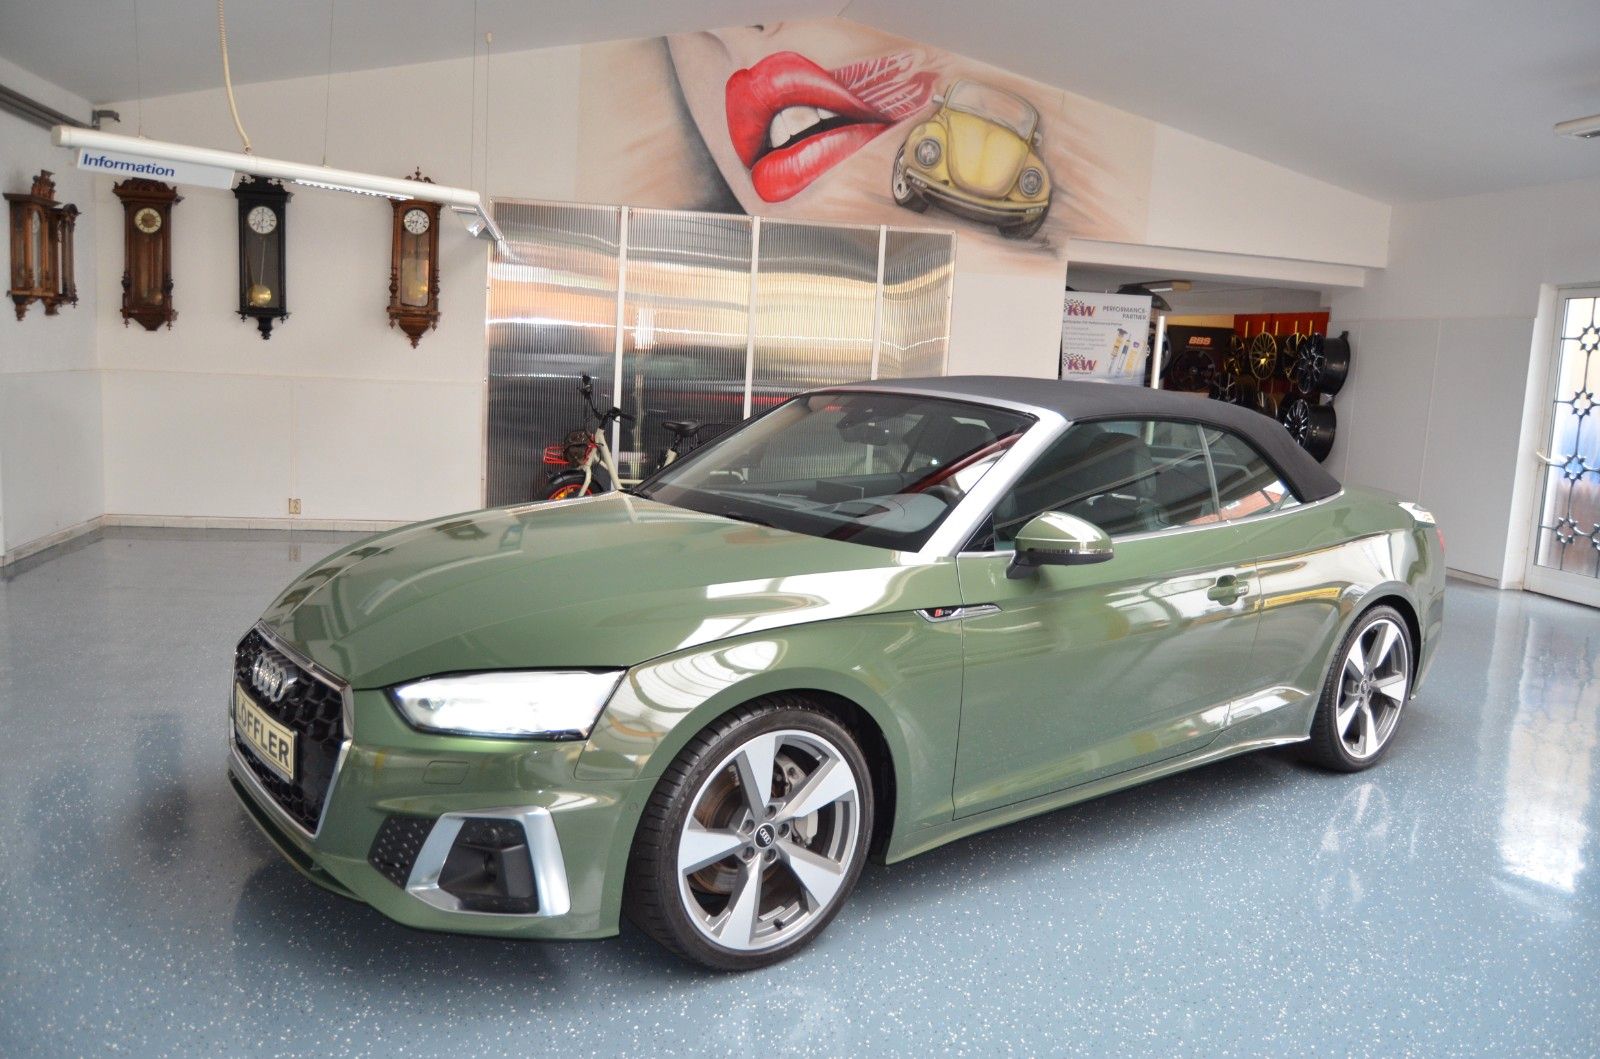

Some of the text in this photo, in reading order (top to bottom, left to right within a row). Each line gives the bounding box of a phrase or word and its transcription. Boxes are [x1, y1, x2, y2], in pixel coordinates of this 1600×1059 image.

[83, 153, 176, 177] Information
[1067, 304, 1096, 316] KW
[1102, 305, 1146, 314] PERFORMANCE
[1189, 336, 1210, 344] BBS
[1067, 359, 1097, 371] KW
